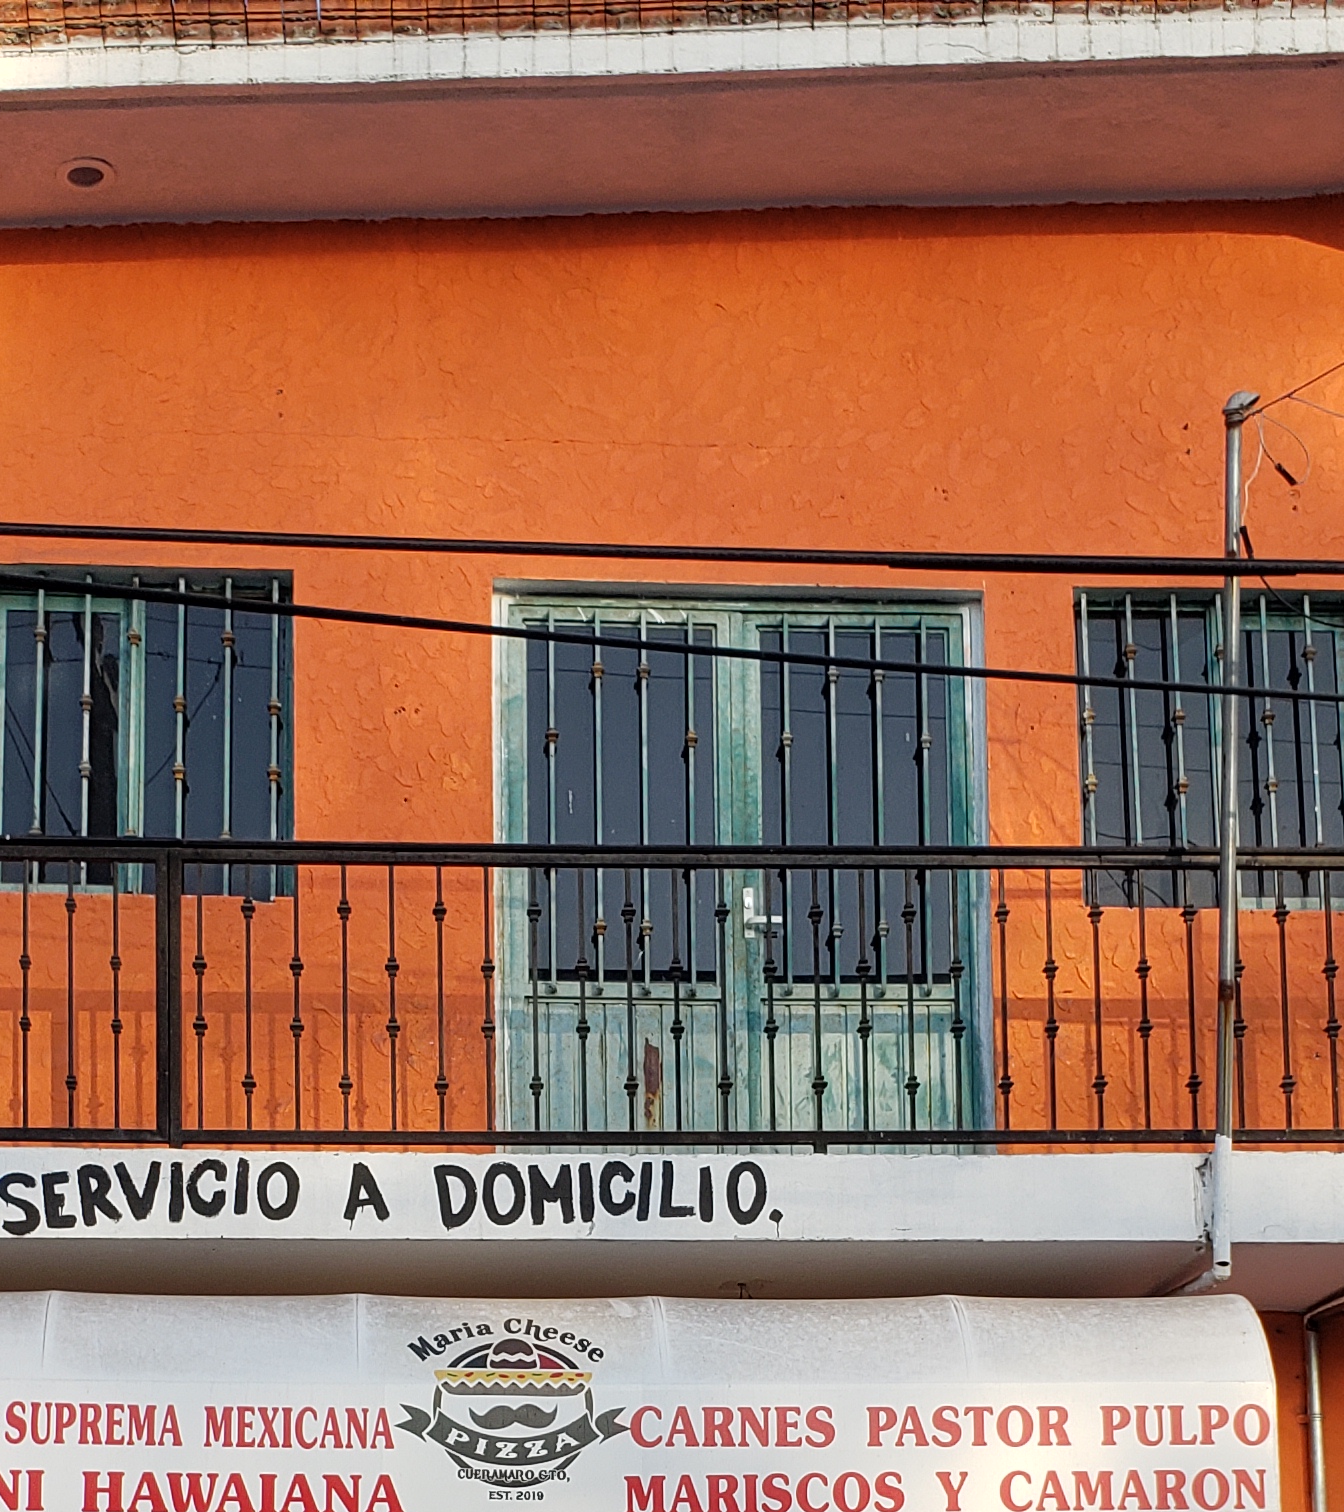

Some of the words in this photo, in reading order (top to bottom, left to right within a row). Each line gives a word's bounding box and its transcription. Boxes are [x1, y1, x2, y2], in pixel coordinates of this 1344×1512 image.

[345, 1162, 389, 1223] A
[407, 1322, 494, 1362] Maria
[503, 1318, 605, 1363] Cheese
[5, 1402, 183, 1447] SUPREMA
[204, 1406, 395, 1450] MEXICANA
[445, 1427, 580, 1459] PIZZA
[629, 1405, 835, 1448] CARNES
[866, 1405, 1072, 1448] PASTOR
[1101, 1404, 1270, 1446] PULPO
[488, 1491, 513, 1501] EST.
[516, 1490, 545, 1501] 2019
[935, 1472, 968, 1512] Y
[999, 1469, 1267, 1512] CAMARON
